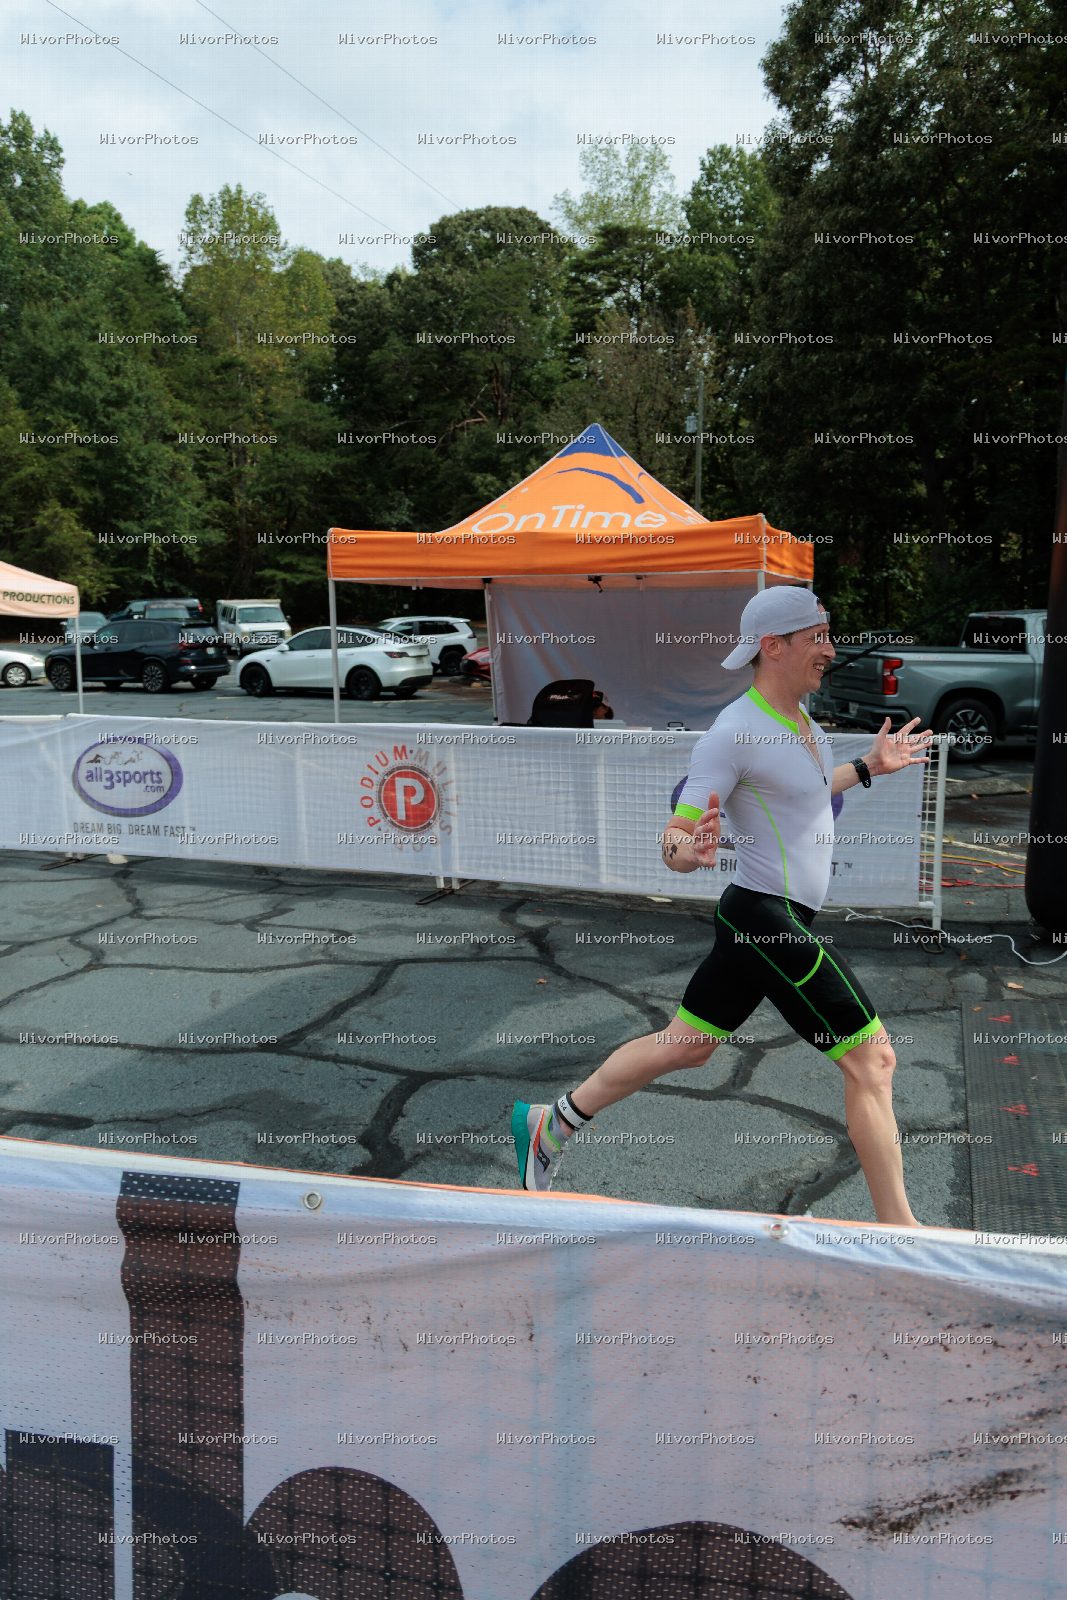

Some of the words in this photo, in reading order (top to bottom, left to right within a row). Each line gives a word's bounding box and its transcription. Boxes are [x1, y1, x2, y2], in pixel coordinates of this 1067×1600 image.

[2, 591, 75, 605] PRODUCTIONS
[86, 767, 163, 790] all3sports
[359, 745, 409, 827] PODIUM
[143, 785, 165, 793] .com
[394, 777, 426, 820] P
[73, 822, 104, 834] DREAM
[128, 824, 160, 837] DREAM
